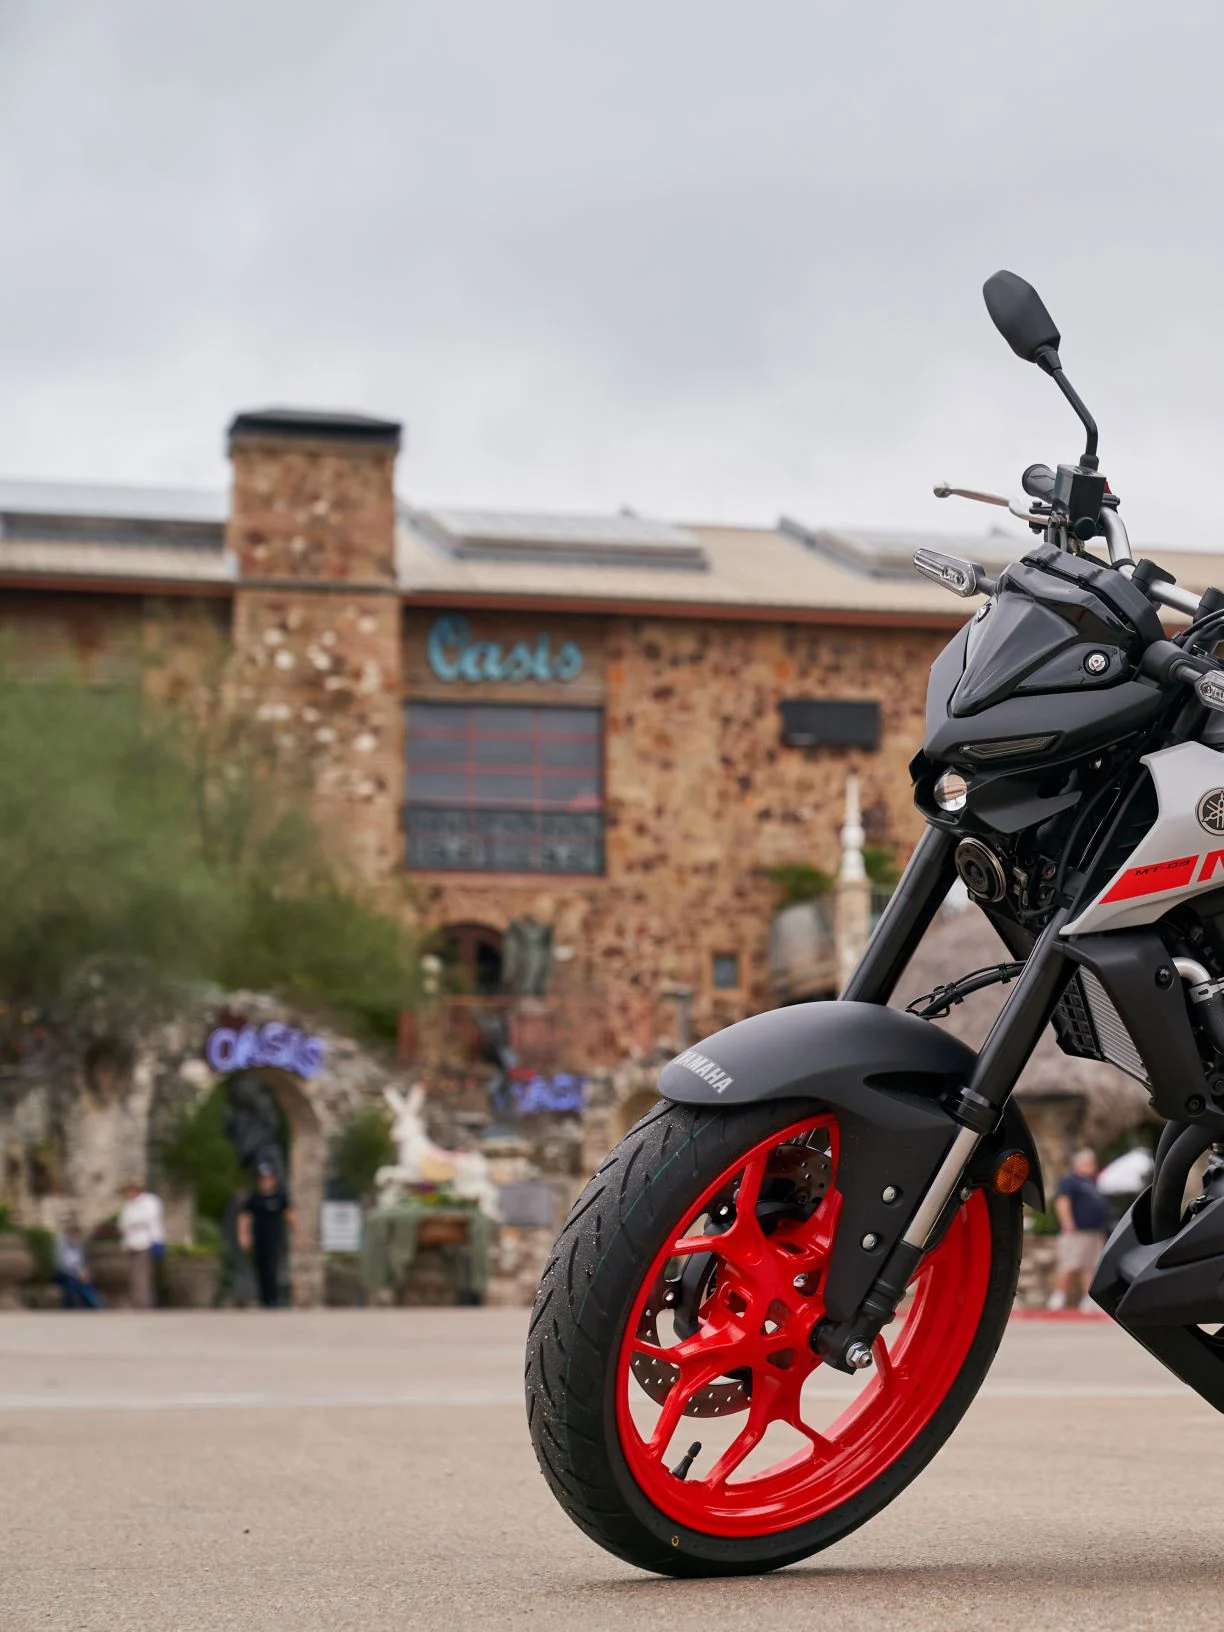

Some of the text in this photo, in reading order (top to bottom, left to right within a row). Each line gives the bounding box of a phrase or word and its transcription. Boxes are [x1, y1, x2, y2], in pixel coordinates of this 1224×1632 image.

[1134, 859, 1190, 877] MT-03
[206, 1021, 328, 1078] OASIS
[671, 1049, 734, 1094] YAMAHA
